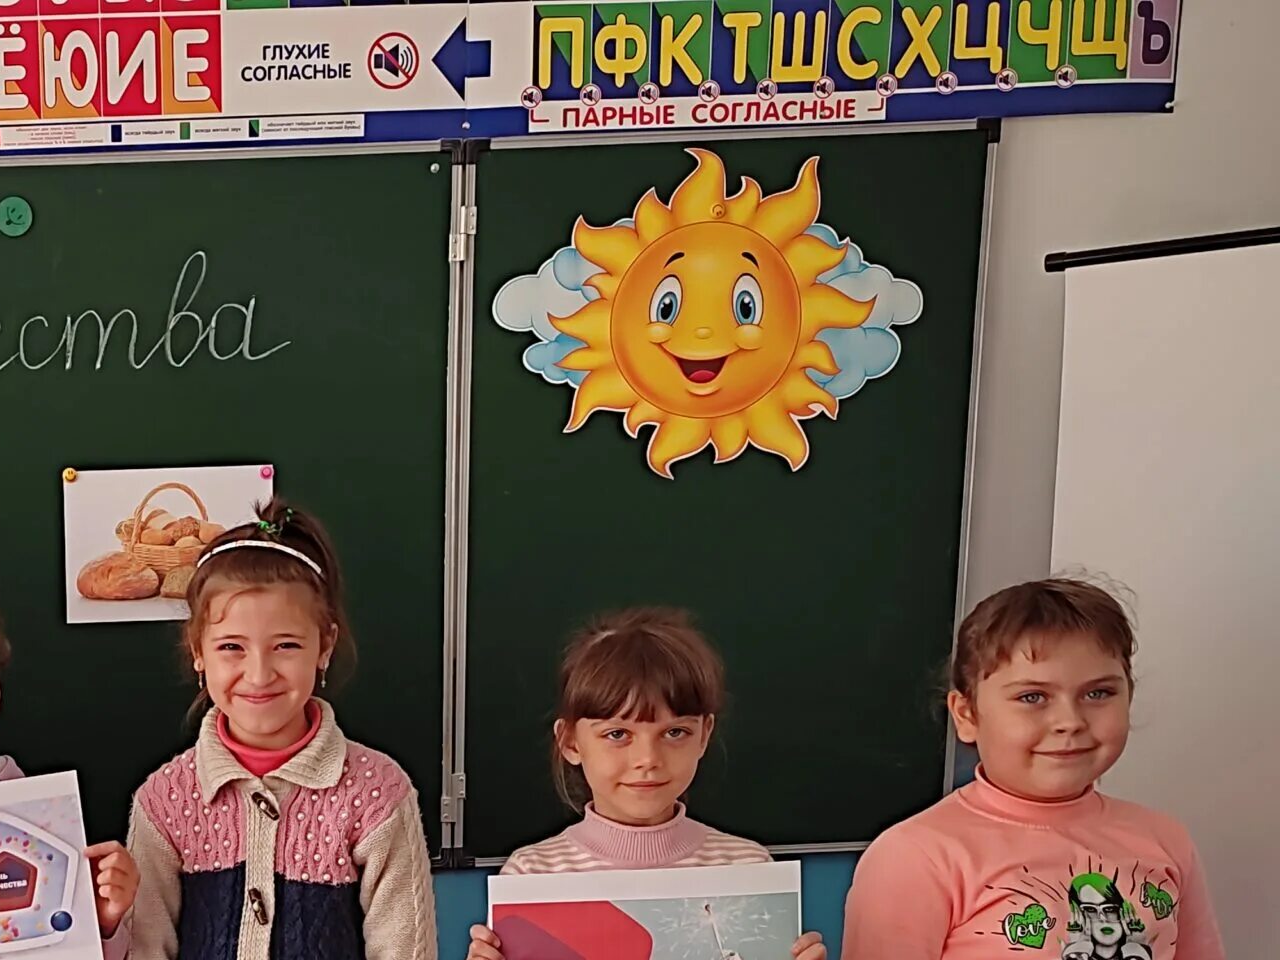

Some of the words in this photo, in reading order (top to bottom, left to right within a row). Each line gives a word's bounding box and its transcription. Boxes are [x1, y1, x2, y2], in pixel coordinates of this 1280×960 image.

[262, 43, 330, 61] ГЛУХИЕ
[241, 63, 352, 82] СОГЛАСНЫЕ
[562, 104, 675, 128] ПАРНЫЕ
[690, 98, 856, 123] СОГЛАСНЫЕ
[1002, 913, 1056, 946] love
